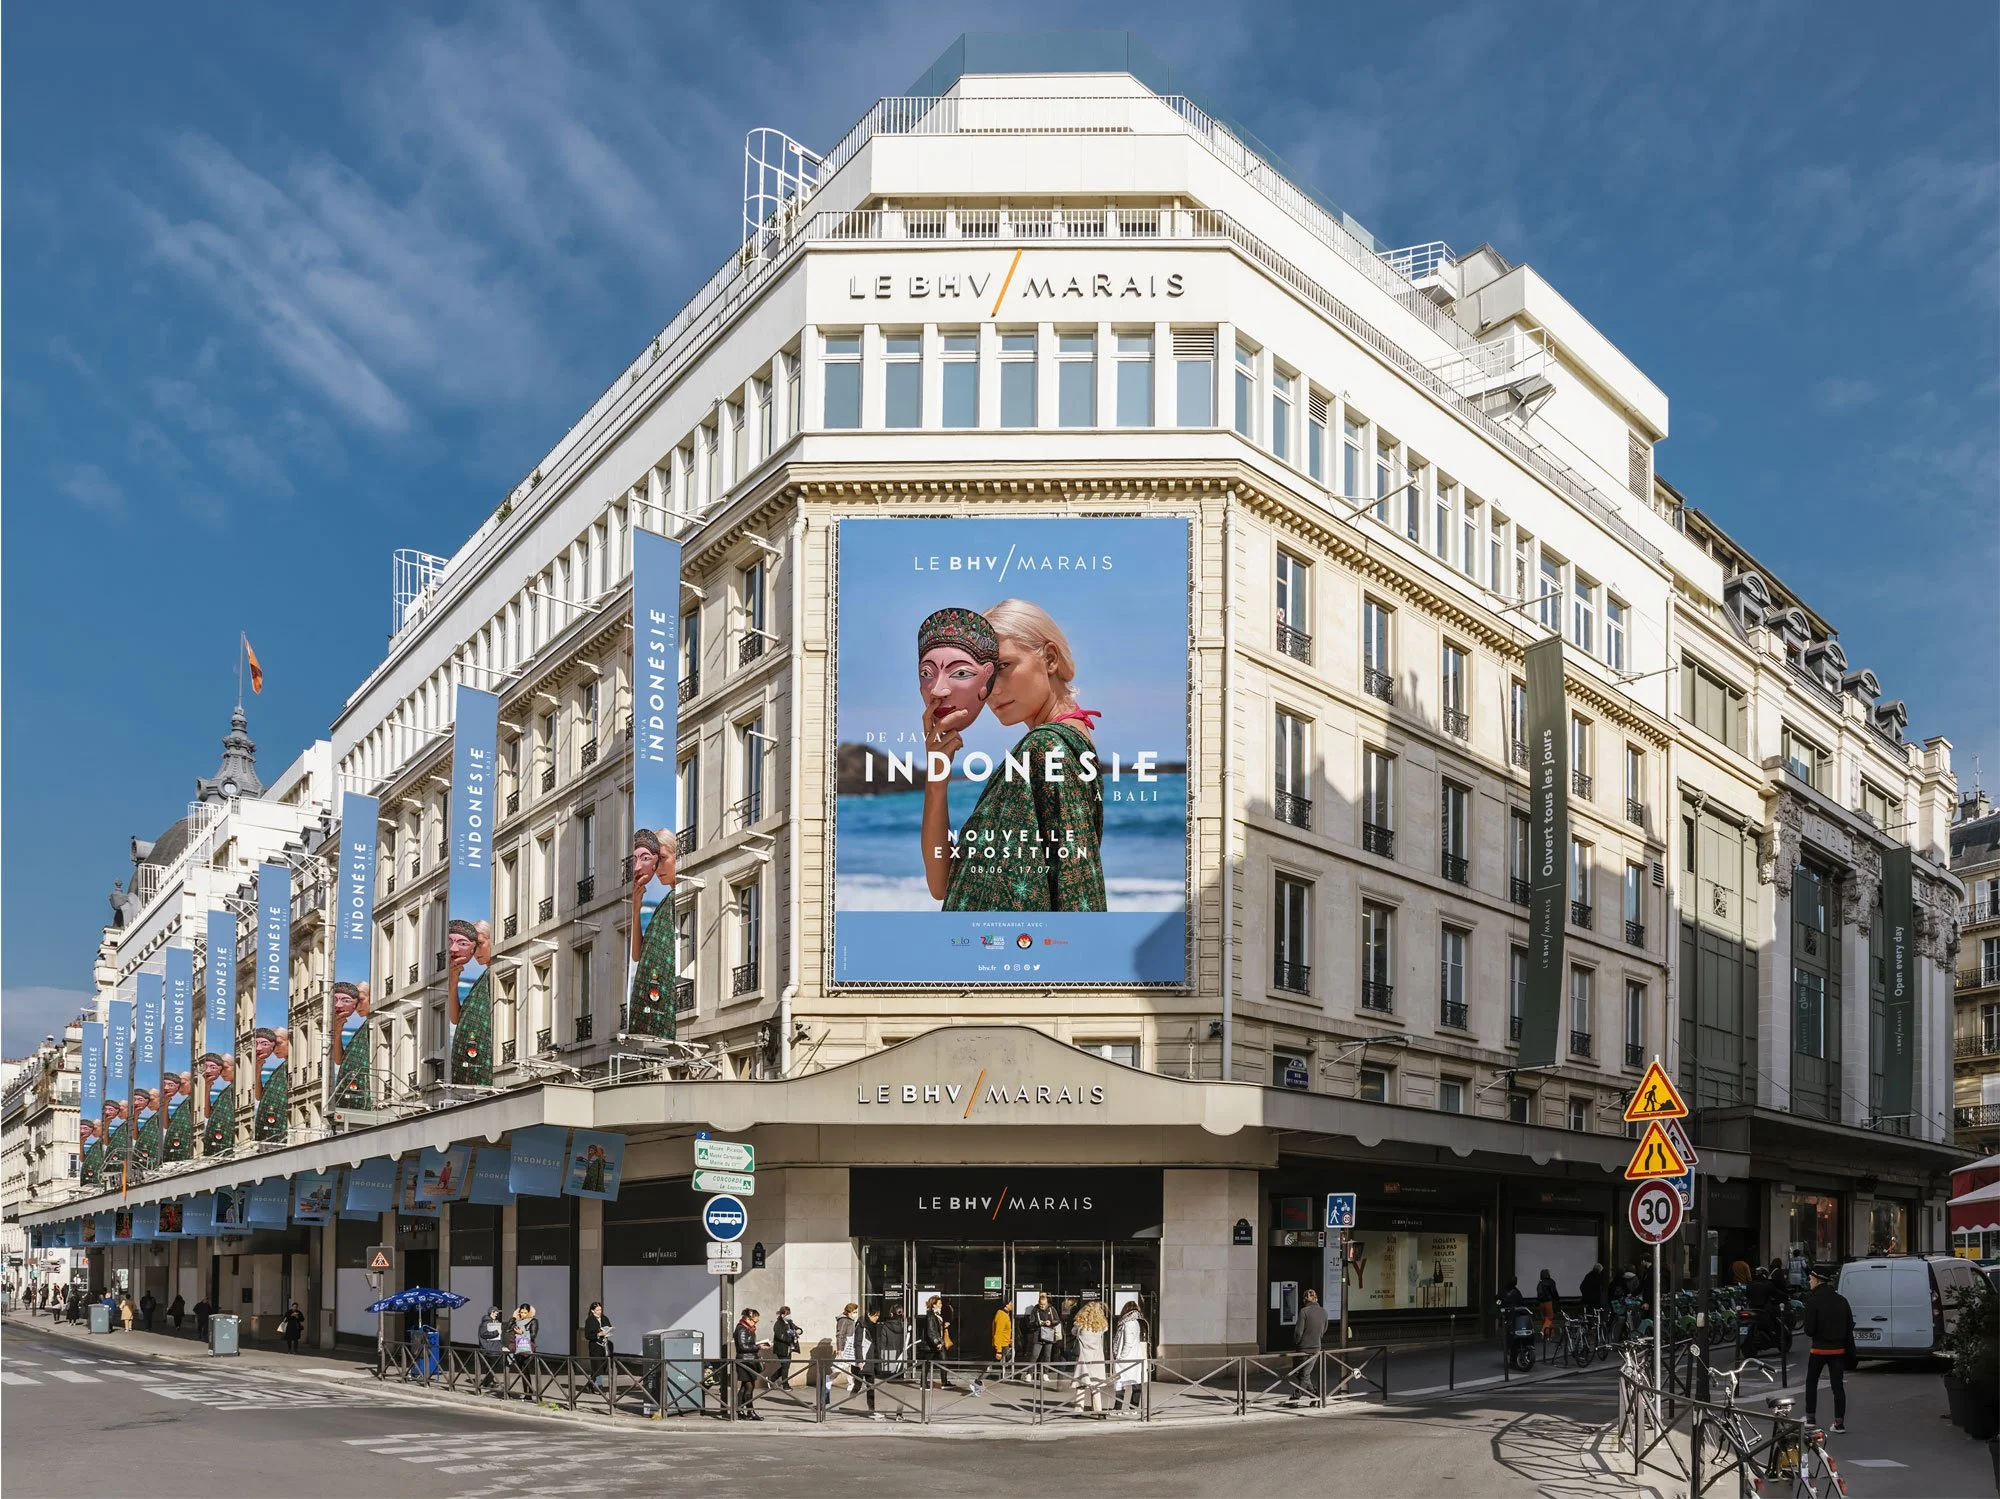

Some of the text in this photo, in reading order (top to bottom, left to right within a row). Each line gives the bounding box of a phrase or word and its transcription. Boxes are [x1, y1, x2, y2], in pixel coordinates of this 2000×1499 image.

[849, 274, 892, 299] LE
[914, 556, 939, 570] LE
[648, 609, 666, 762] INDONÉSIE
[866, 732, 943, 743] DE JAVA
[866, 750, 1158, 785] INDONÉSIE
[1113, 791, 1158, 801] BALI
[1542, 729, 1555, 877] Ouvert tous les jours
[467, 748, 483, 868] INDONÉSIE
[947, 829, 1075, 842] NOUVELLE
[934, 846, 1088, 859] EXPOSITION
[970, 865, 1003, 874] 08.06
[1018, 865, 1051, 874] 17.07
[351, 843, 366, 940] INDONÉSIE
[268, 907, 281, 991] INDONÉSIE
[1543, 958, 1549, 969] LE
[1893, 926, 1904, 997] Open every day
[215, 947, 227, 1021] INDONÉSIE
[858, 1085, 890, 1104] LE
[713, 1175, 743, 1184] CONCORDE
[919, 1196, 941, 1210] LE
[1640, 1197, 1670, 1226] 30
